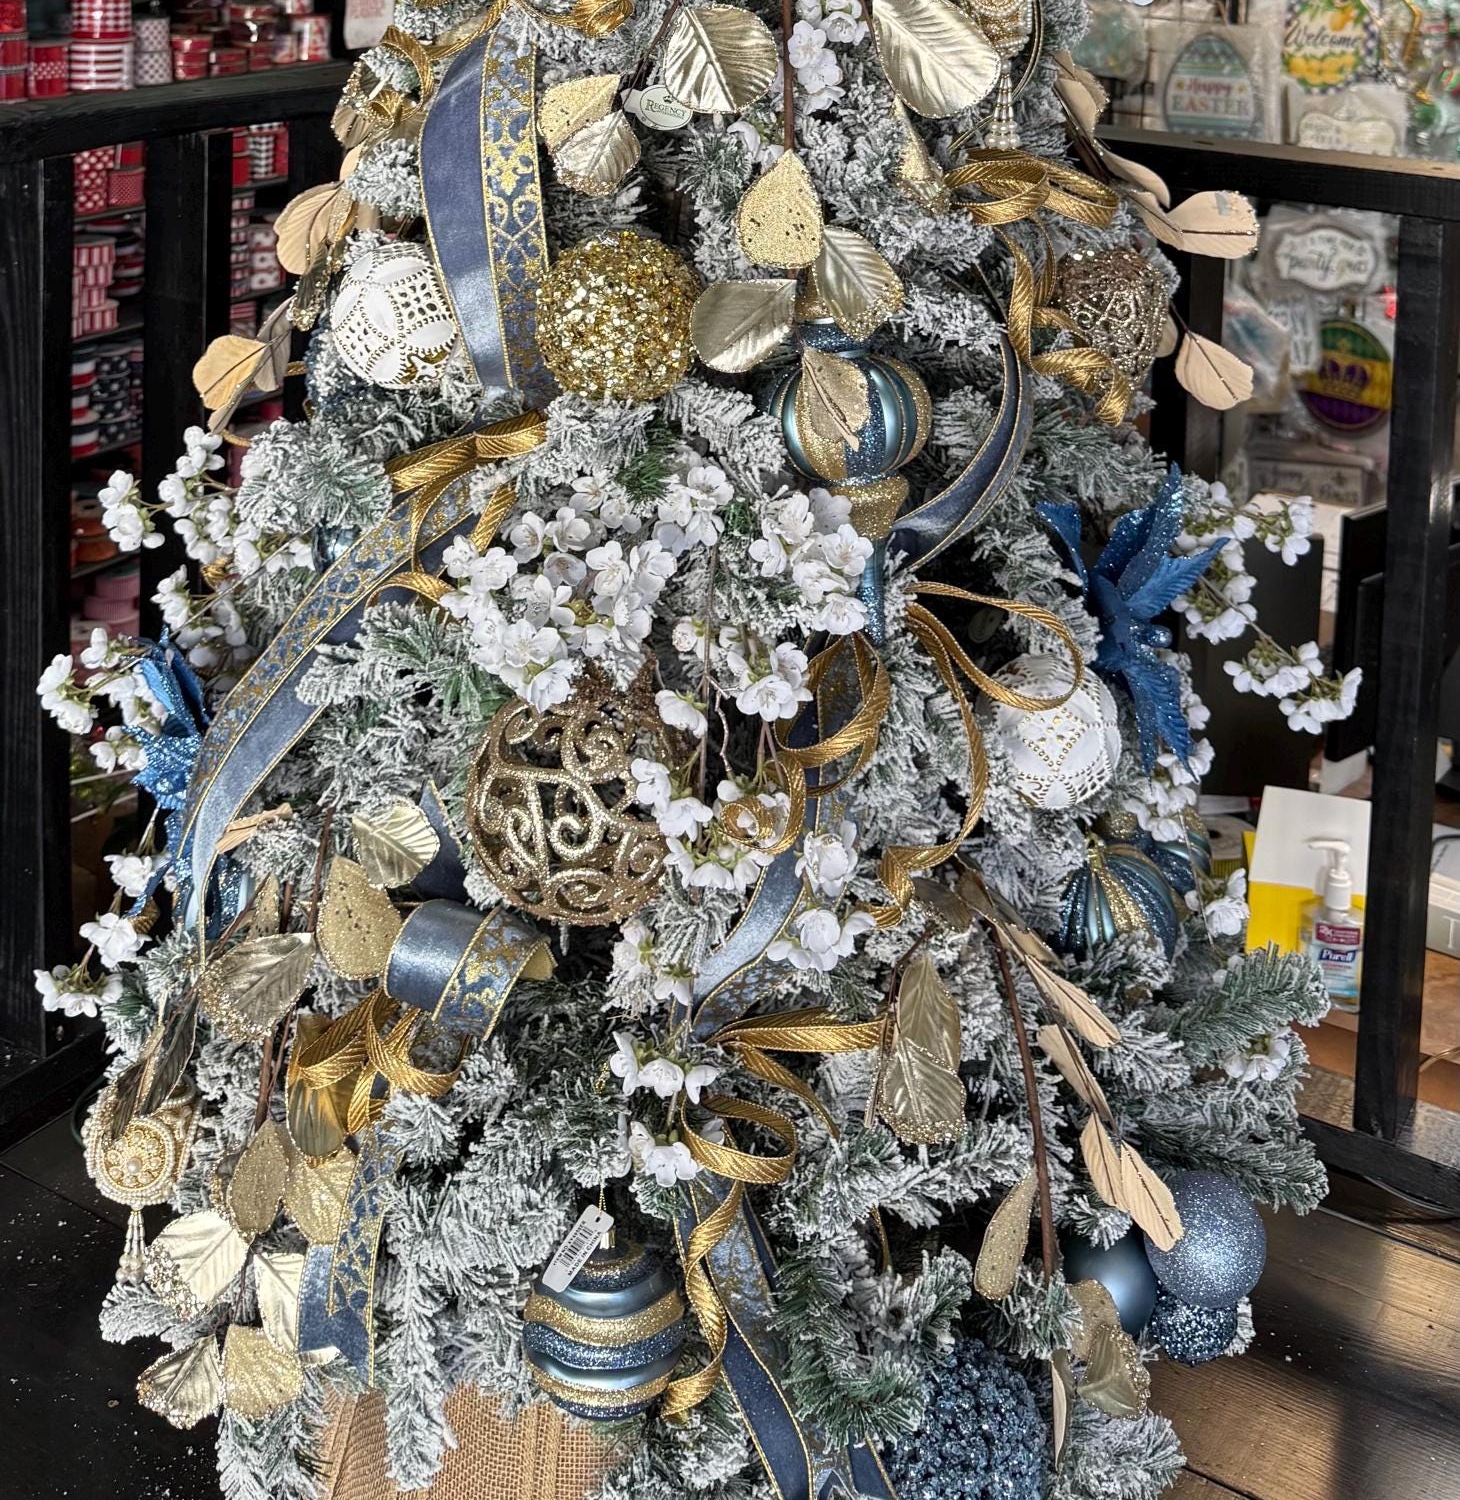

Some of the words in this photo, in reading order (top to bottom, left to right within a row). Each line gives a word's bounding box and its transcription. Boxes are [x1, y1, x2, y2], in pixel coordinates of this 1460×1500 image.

[1284, 20, 1362, 49] Welcome
[1186, 78, 1233, 98] Happy
[645, 99, 686, 118] REGENCY
[1172, 95, 1249, 116] EASTER
[1322, 949, 1353, 961] Purell
[568, 1258, 581, 1275] MADE
[586, 1231, 602, 1251] CHINA
